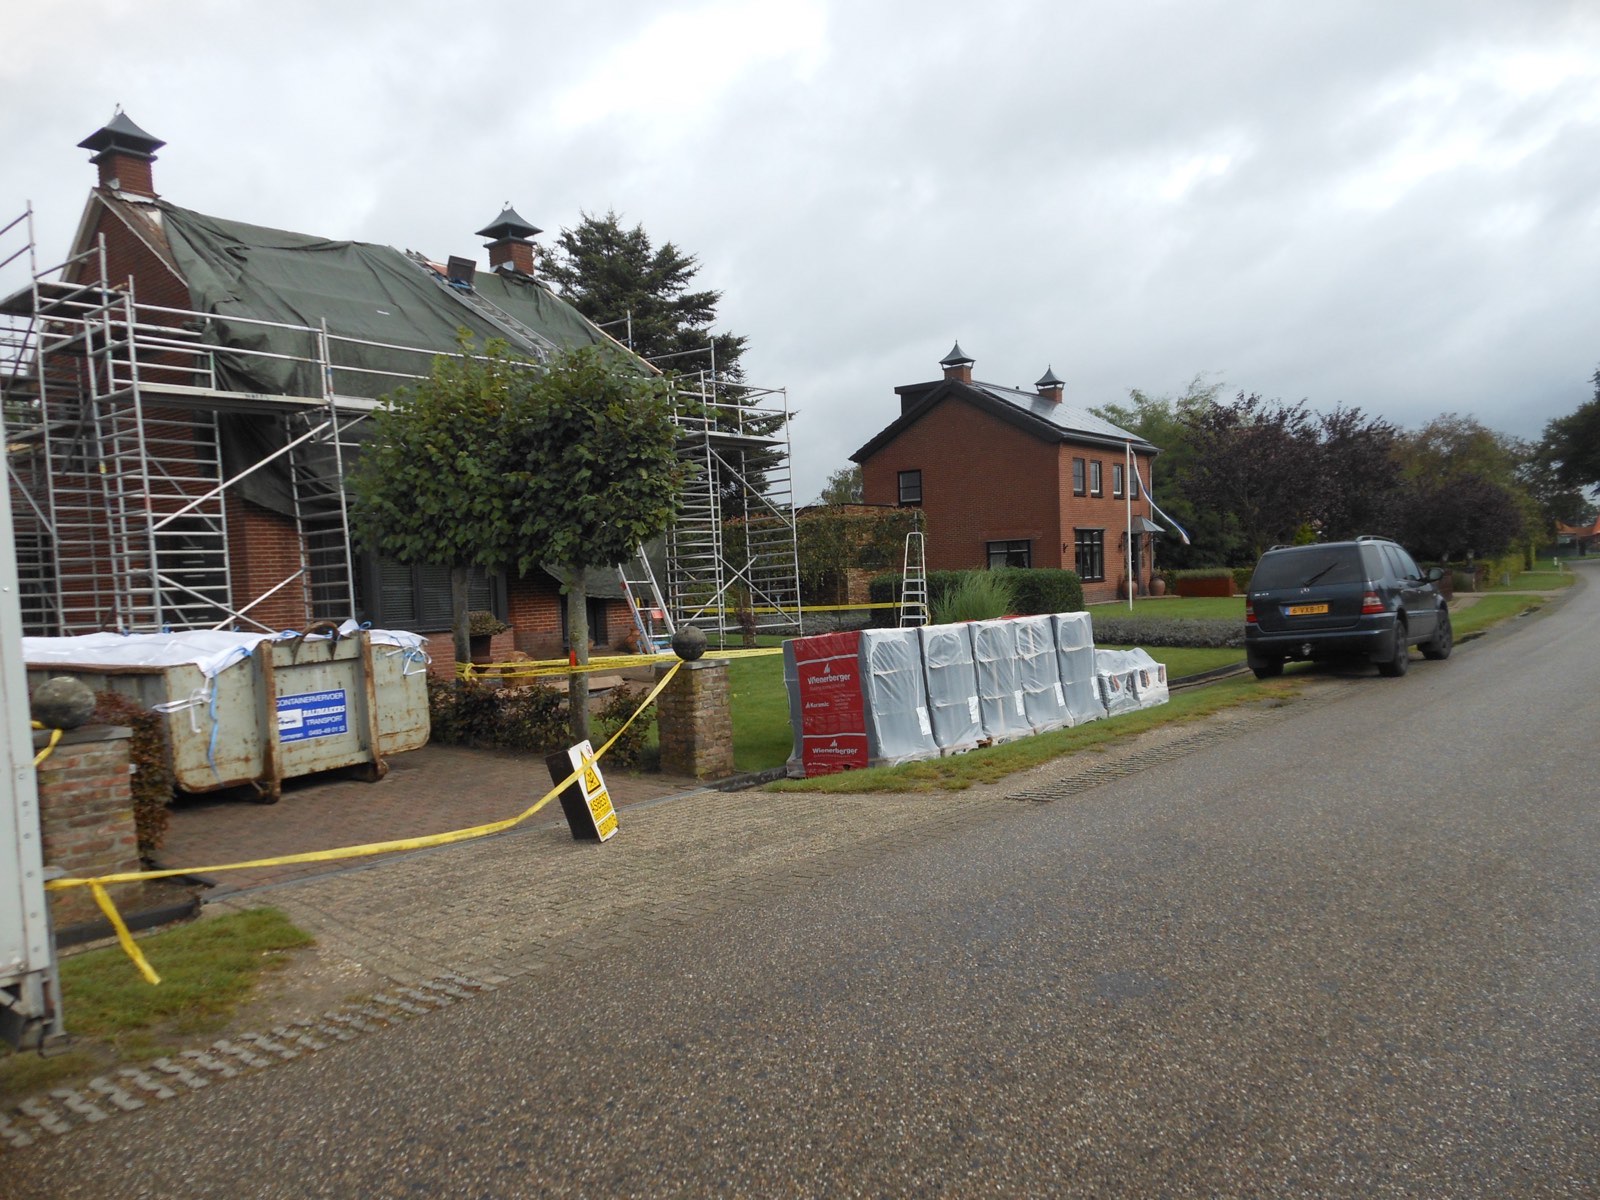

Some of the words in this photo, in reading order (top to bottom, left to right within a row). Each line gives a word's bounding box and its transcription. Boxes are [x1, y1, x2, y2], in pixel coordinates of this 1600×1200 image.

[807, 673, 851, 685] Wienerberger
[306, 715, 343, 726] TRANSPORT
[812, 747, 858, 755] Wienerberger
[590, 791, 608, 812] ASBEST
